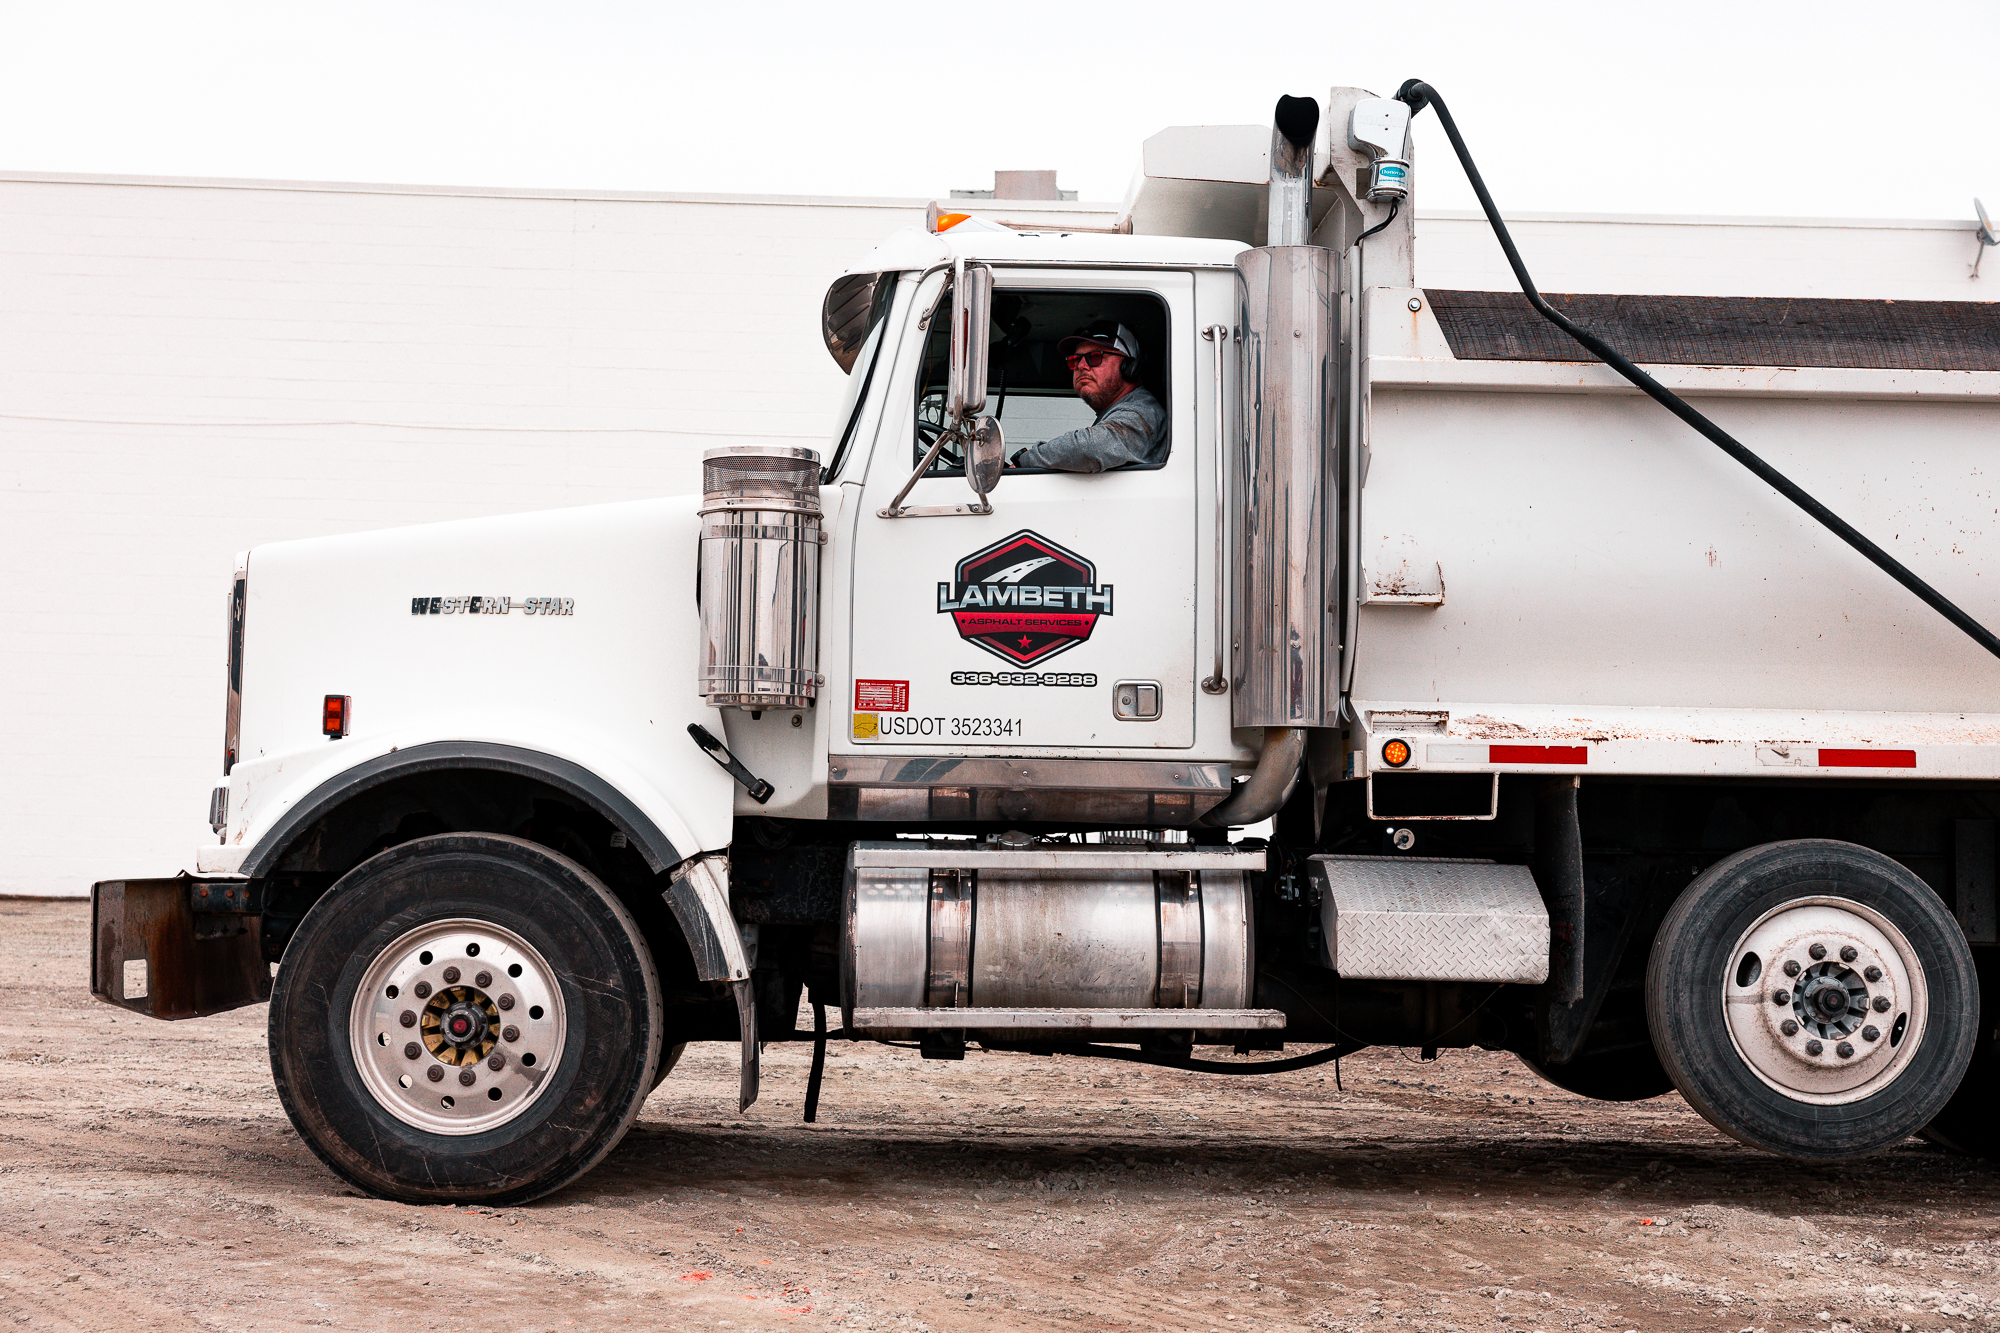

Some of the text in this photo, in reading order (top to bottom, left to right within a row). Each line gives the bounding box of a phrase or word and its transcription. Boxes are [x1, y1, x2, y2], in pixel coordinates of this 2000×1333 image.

[411, 595, 575, 616] WESTERN STAR
[938, 583, 1112, 615] LAMBETH
[967, 618, 1082, 627] ASPHALT SERVICES
[951, 672, 1098, 687] 336-932-9288
[879, 716, 1023, 737] USDOT 3523341
